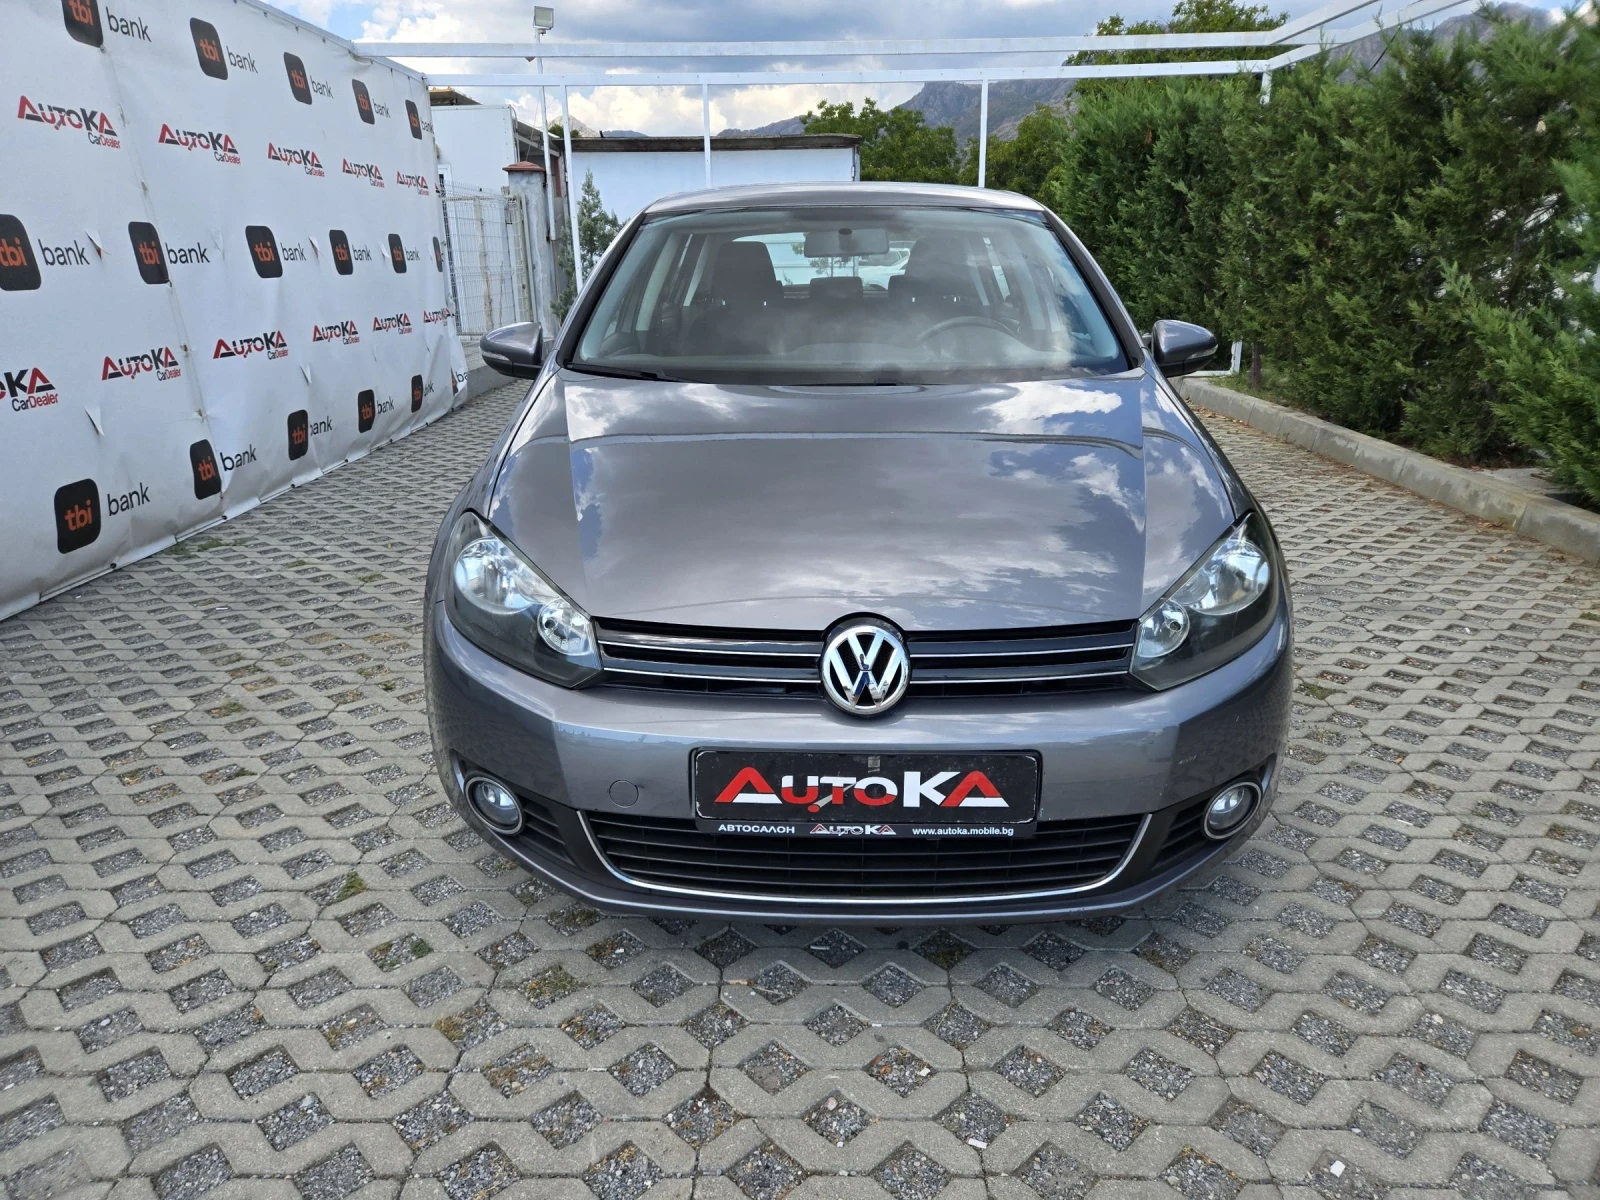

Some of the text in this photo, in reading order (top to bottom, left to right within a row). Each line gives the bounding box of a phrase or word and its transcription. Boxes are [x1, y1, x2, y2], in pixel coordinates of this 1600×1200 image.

[69, 0, 152, 42] tbi bank
[200, 38, 259, 74] tbi bank
[291, 69, 334, 99] tbi bank
[372, 99, 391, 118] bank
[38, 239, 90, 266] bank
[139, 241, 210, 265] tbi bank
[255, 242, 306, 262] tbi bank
[335, 244, 372, 261] tbi bank
[405, 246, 420, 261] bank
[362, 396, 395, 420] tbi bank
[292, 424, 305, 445] tbi
[198, 444, 257, 481] tbi bank
[64, 483, 150, 531] tbi bank
[717, 823, 796, 834] АВТОСАЛОН
[912, 826, 1014, 838] www.autoka.mobile.bg
